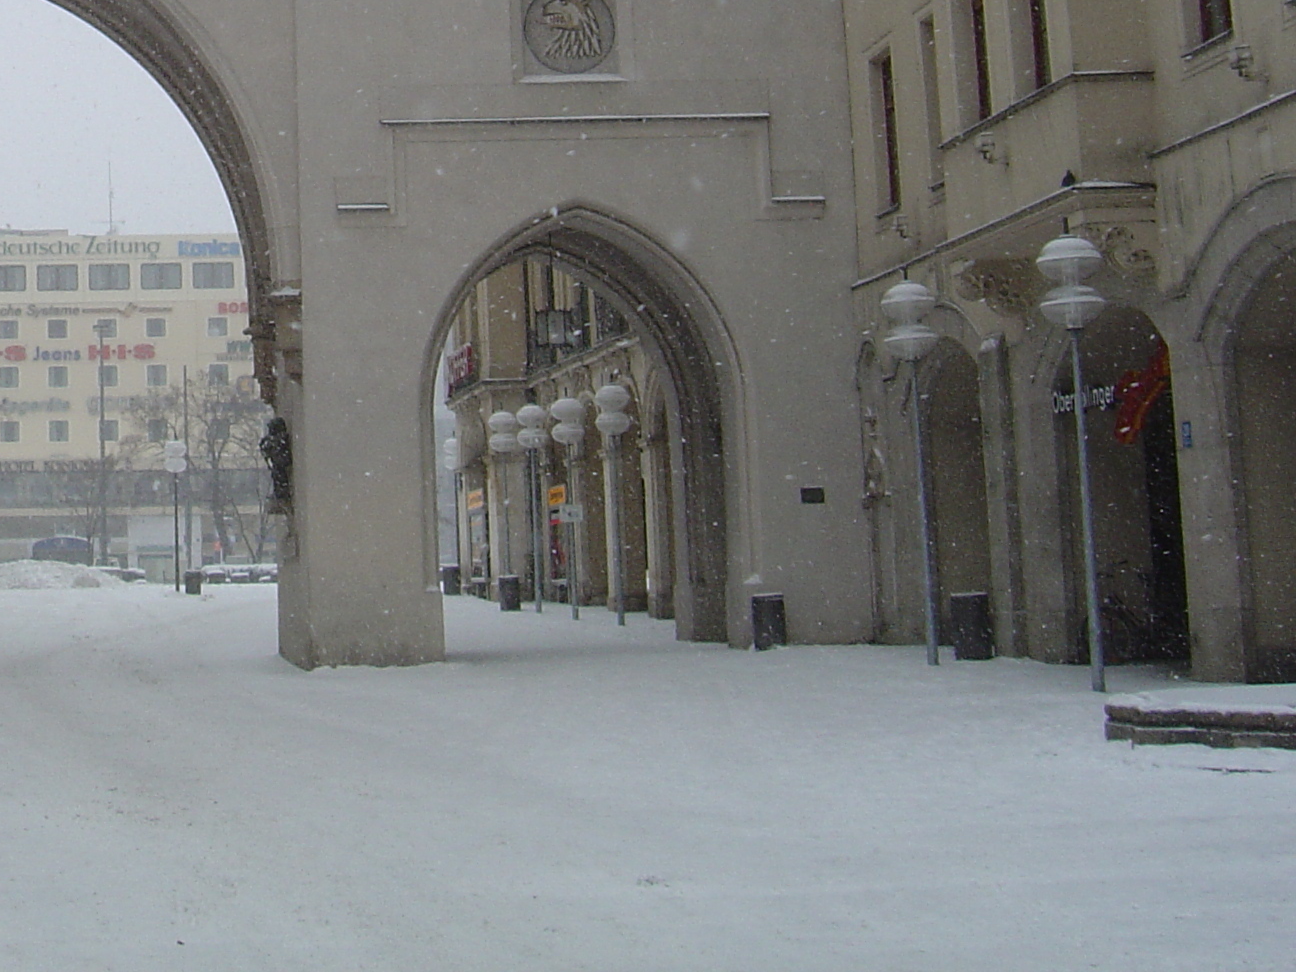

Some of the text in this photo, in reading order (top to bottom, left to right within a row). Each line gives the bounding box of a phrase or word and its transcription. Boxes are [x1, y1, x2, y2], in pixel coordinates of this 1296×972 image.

[83, 234, 160, 259] Zeitung
[26, 303, 81, 318] Systeme
[217, 302, 249, 315] BOS
[33, 345, 81, 361] Jeans
